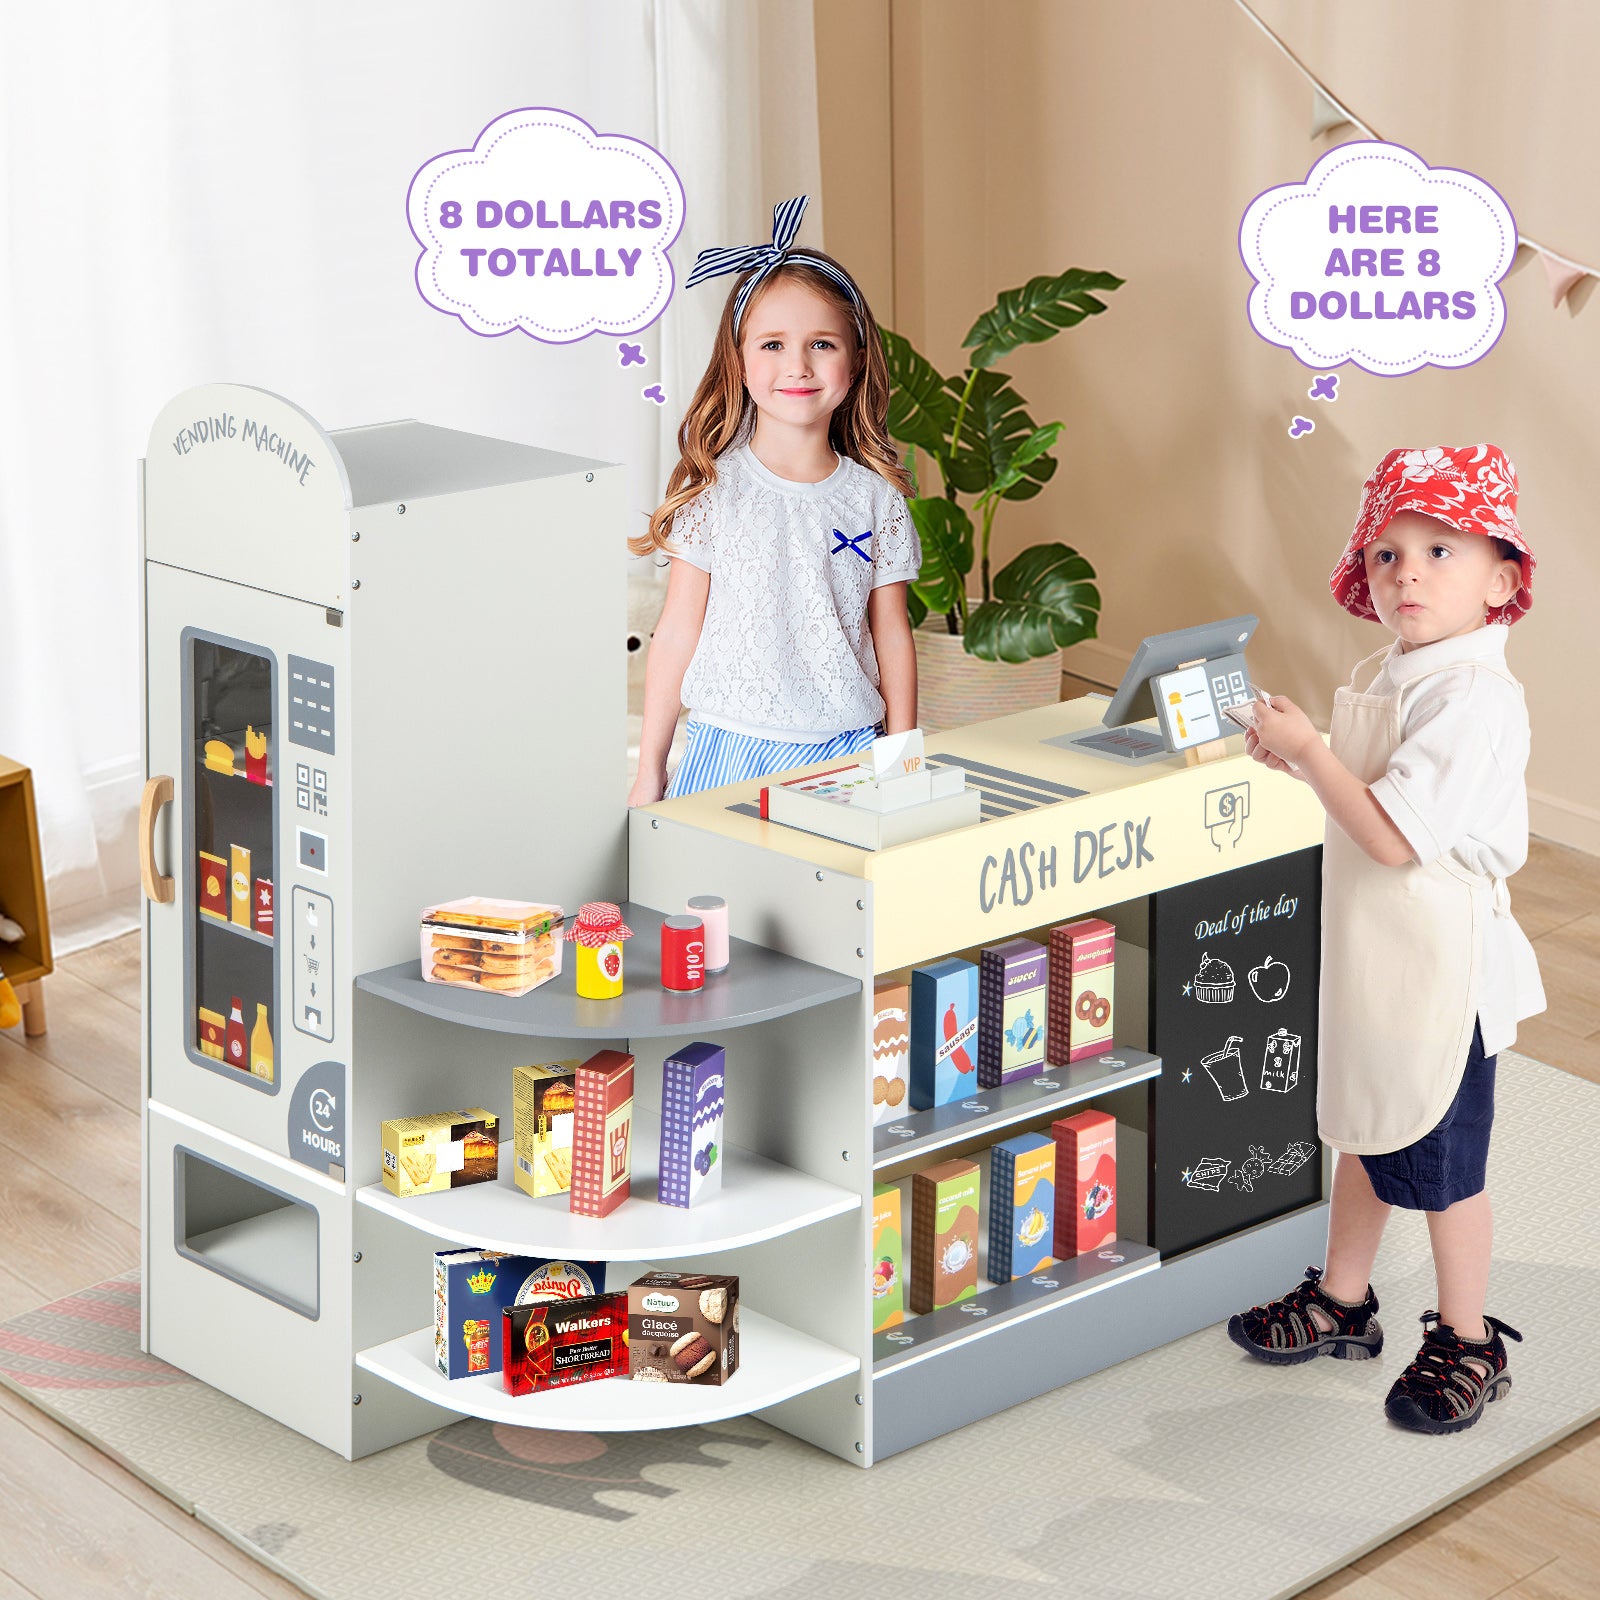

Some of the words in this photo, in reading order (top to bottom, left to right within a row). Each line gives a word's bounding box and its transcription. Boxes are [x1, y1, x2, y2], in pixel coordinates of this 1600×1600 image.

[172, 413, 237, 455] VENDING
[242, 418, 315, 486] MACHINE
[903, 756, 921, 774] VIP
[980, 841, 1057, 913] CASH
[1073, 816, 1154, 883] DESK
[1195, 909, 1232, 940] Deal
[1231, 904, 1249, 935] of
[1250, 900, 1270, 924] the
[1273, 893, 1298, 919] day
[686, 941, 704, 980] Cola
[939, 1023, 976, 1057] sausage
[315, 1100, 330, 1118] 24
[302, 1129, 341, 1157] HOURS
[555, 1317, 611, 1334] Walkers
[555, 1350, 611, 1365] SHORTBREAD
